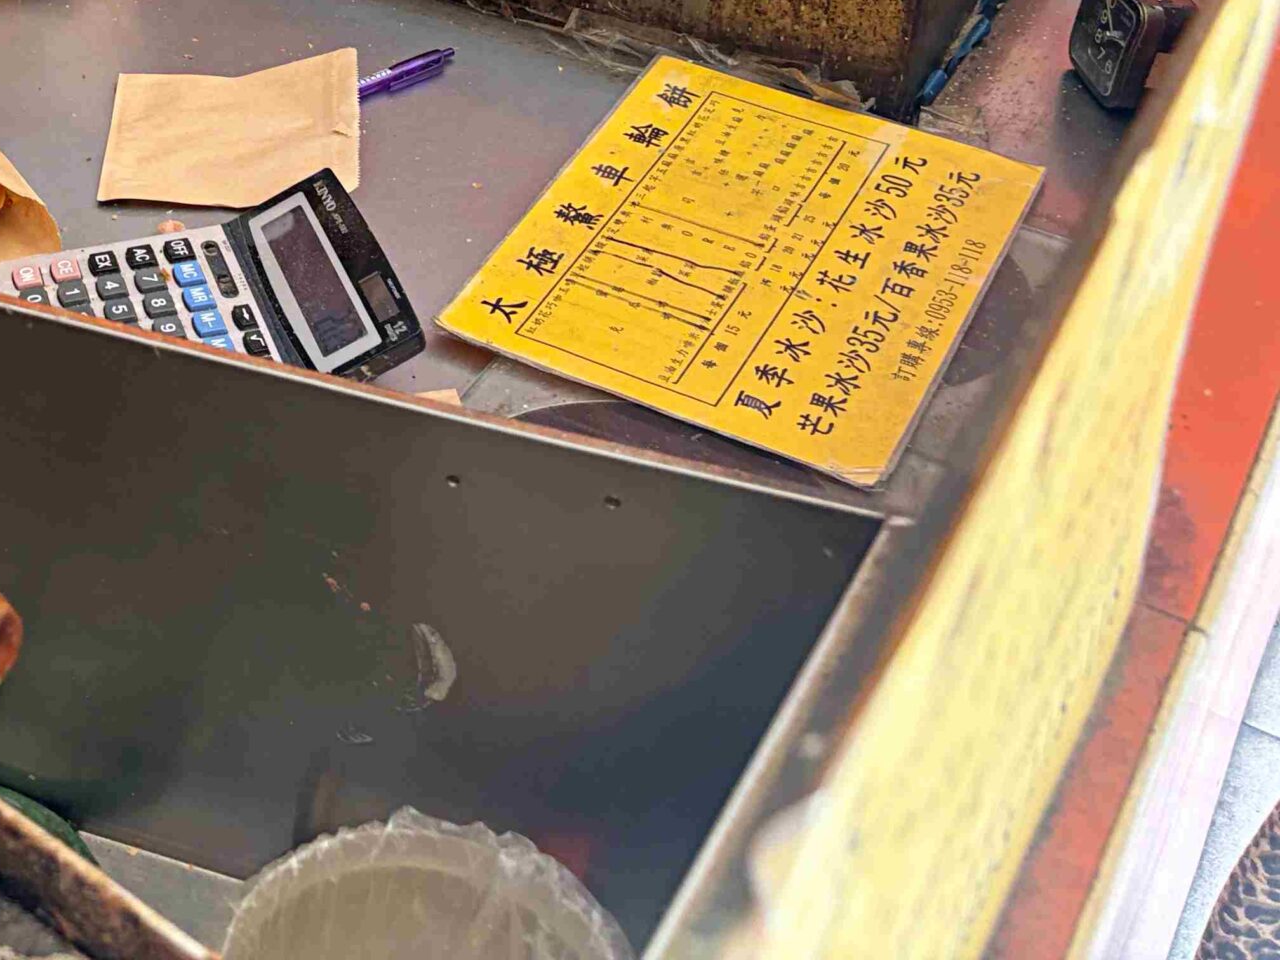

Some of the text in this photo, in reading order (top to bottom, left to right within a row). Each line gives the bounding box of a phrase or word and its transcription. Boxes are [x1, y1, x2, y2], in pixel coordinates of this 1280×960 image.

[132, 248, 151, 262] AC
[170, 240, 190, 256] OFF
[57, 260, 74, 275] CE
[95, 254, 113, 269] EX
[20, 267, 36, 282] ON
[142, 274, 158, 282] 7
[180, 263, 198, 279] MC
[65, 288, 81, 296] 1
[104, 281, 120, 290] 4
[190, 287, 209, 303] MR
[112, 304, 128, 315] 5
[151, 298, 167, 308] 8
[160, 323, 176, 333] 9
